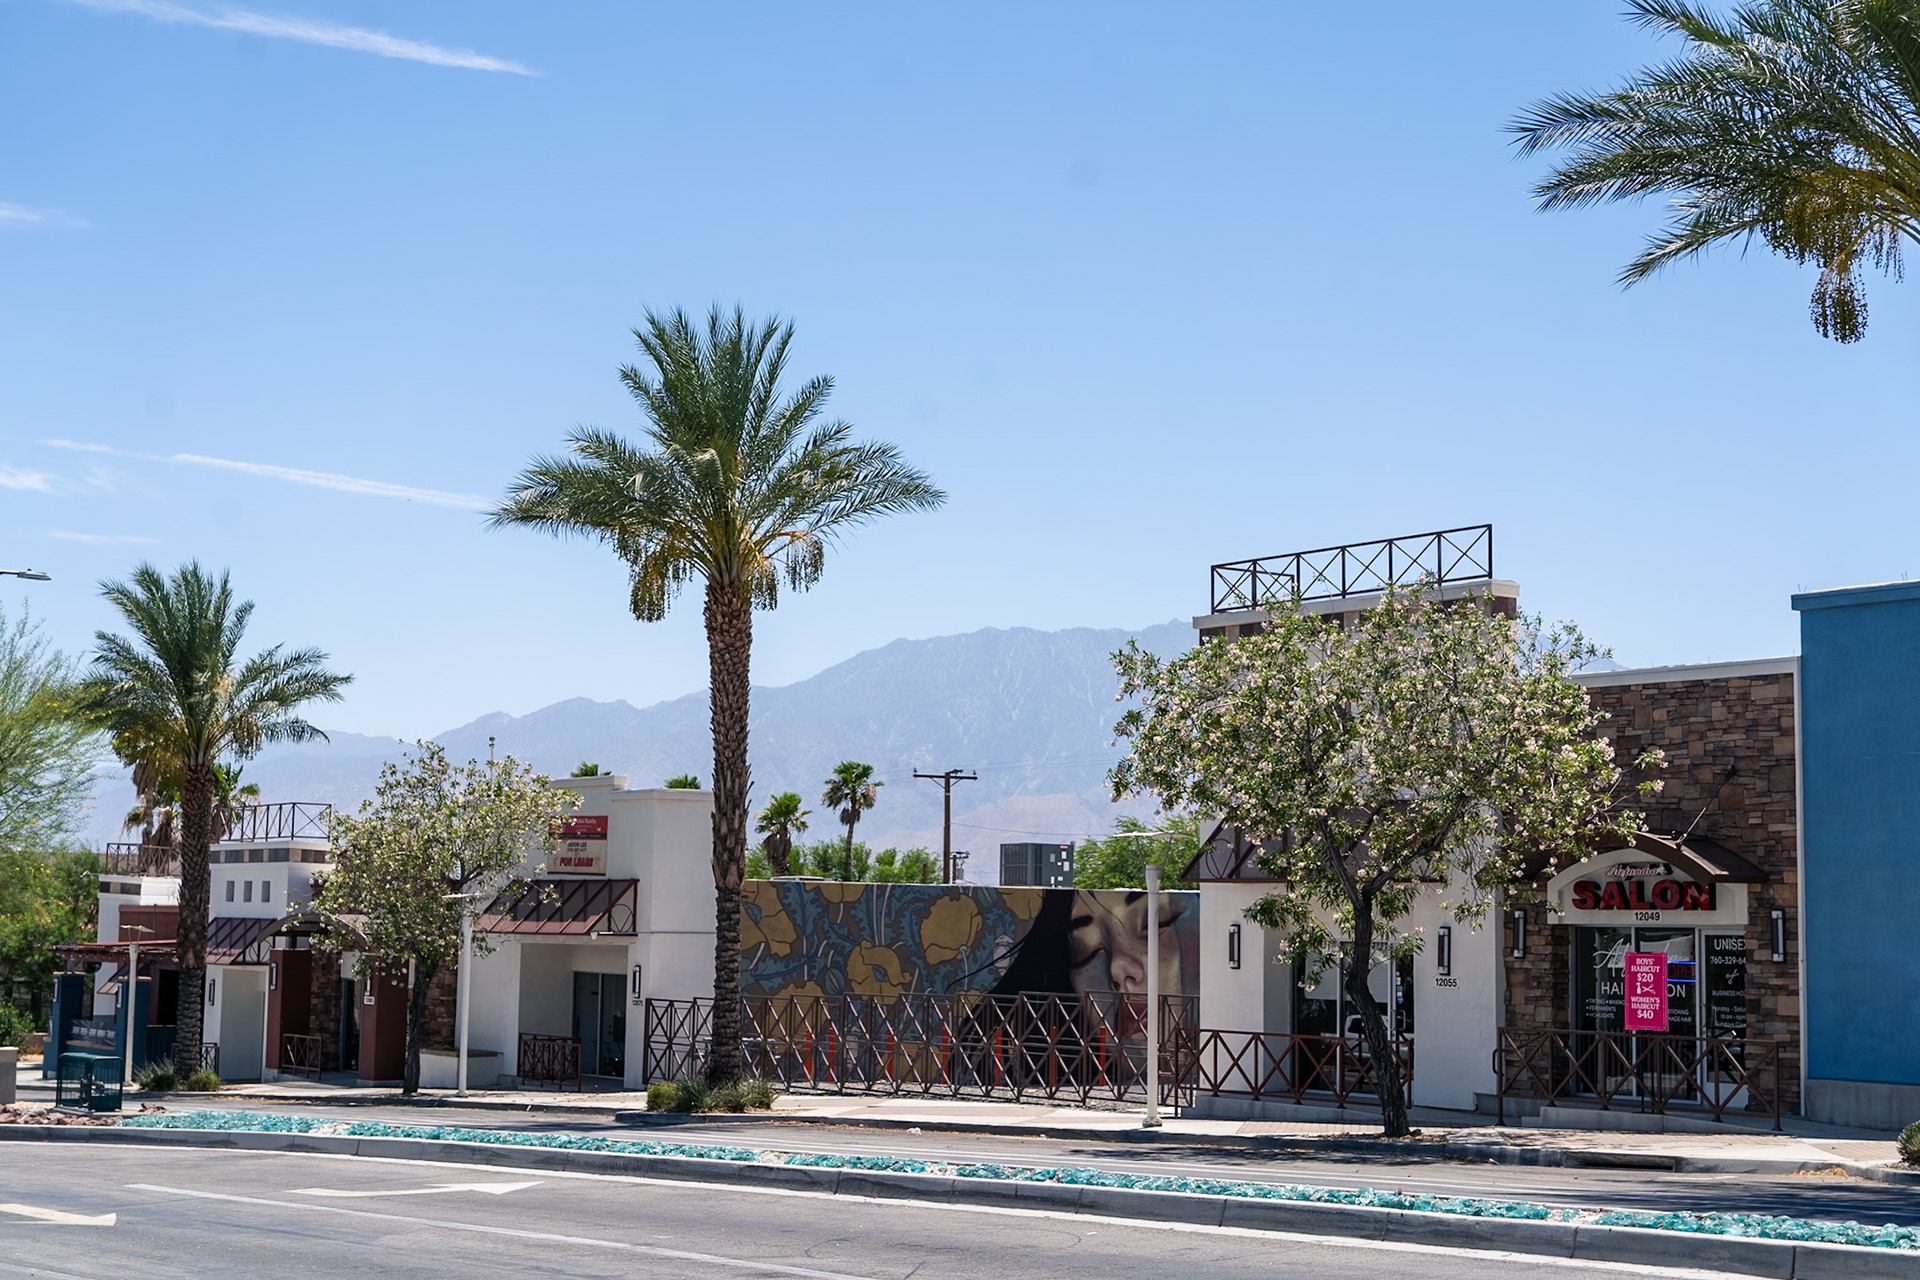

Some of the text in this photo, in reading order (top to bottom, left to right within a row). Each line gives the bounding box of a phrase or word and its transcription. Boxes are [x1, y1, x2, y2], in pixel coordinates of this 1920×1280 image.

[560, 857, 593, 867] FOR LEASE
[1572, 880, 1714, 911] SALON
[1634, 911, 1661, 922] 12049
[1631, 965, 1660, 973] HAIRCUT
[1435, 978, 1458, 988] 12055
[1637, 973, 1654, 983] $20
[1631, 996, 1661, 1004] WOMEN'S
[1637, 1010, 1654, 1020] $40
